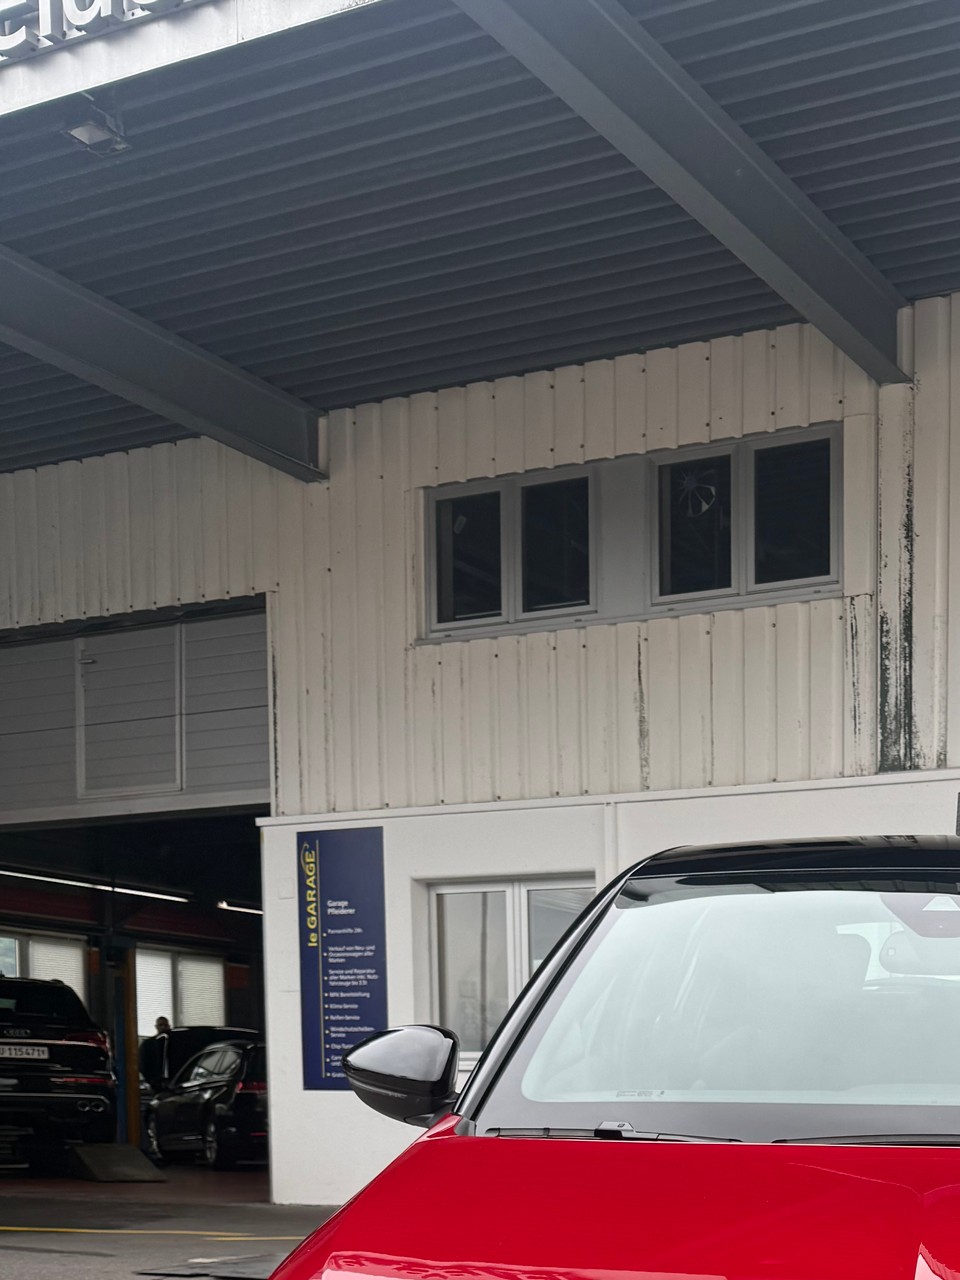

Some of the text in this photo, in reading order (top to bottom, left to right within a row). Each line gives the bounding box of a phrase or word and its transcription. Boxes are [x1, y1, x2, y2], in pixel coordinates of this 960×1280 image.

[305, 850, 318, 947] le GARAGE
[327, 900, 349, 909] Garage
